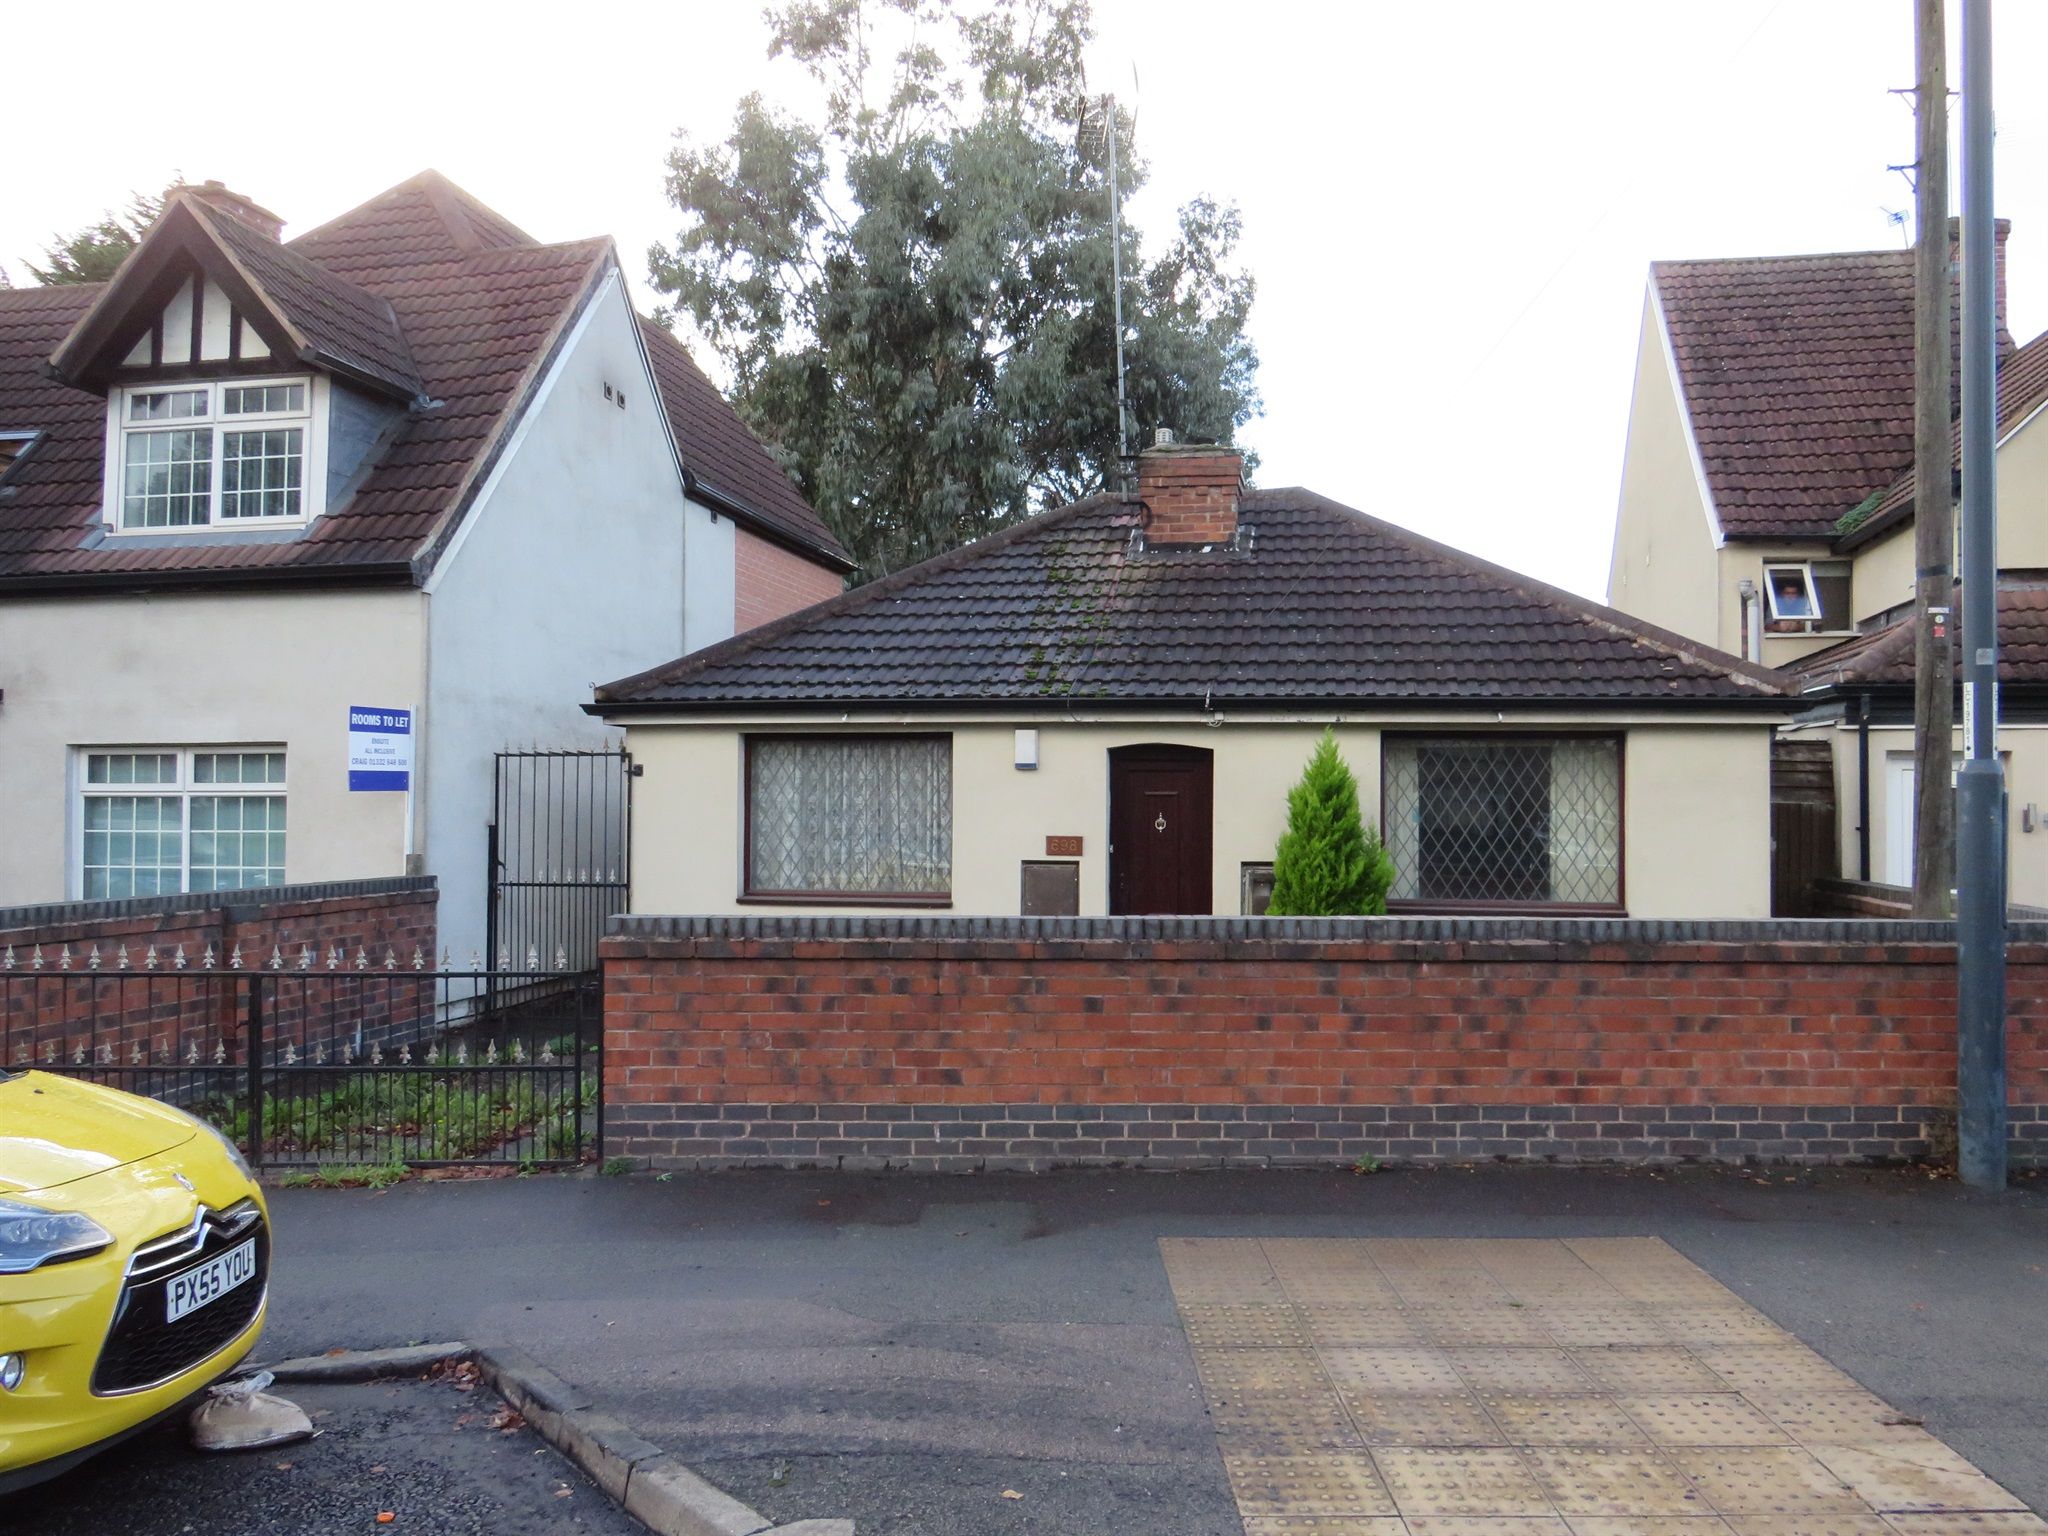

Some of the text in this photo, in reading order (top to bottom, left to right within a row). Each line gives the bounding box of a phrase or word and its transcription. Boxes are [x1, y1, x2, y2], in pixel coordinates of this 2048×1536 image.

[351, 713, 408, 728] ROOMS TO LET
[351, 757, 368, 766] CRAIG
[175, 1246, 250, 1315] PX55 YOU
